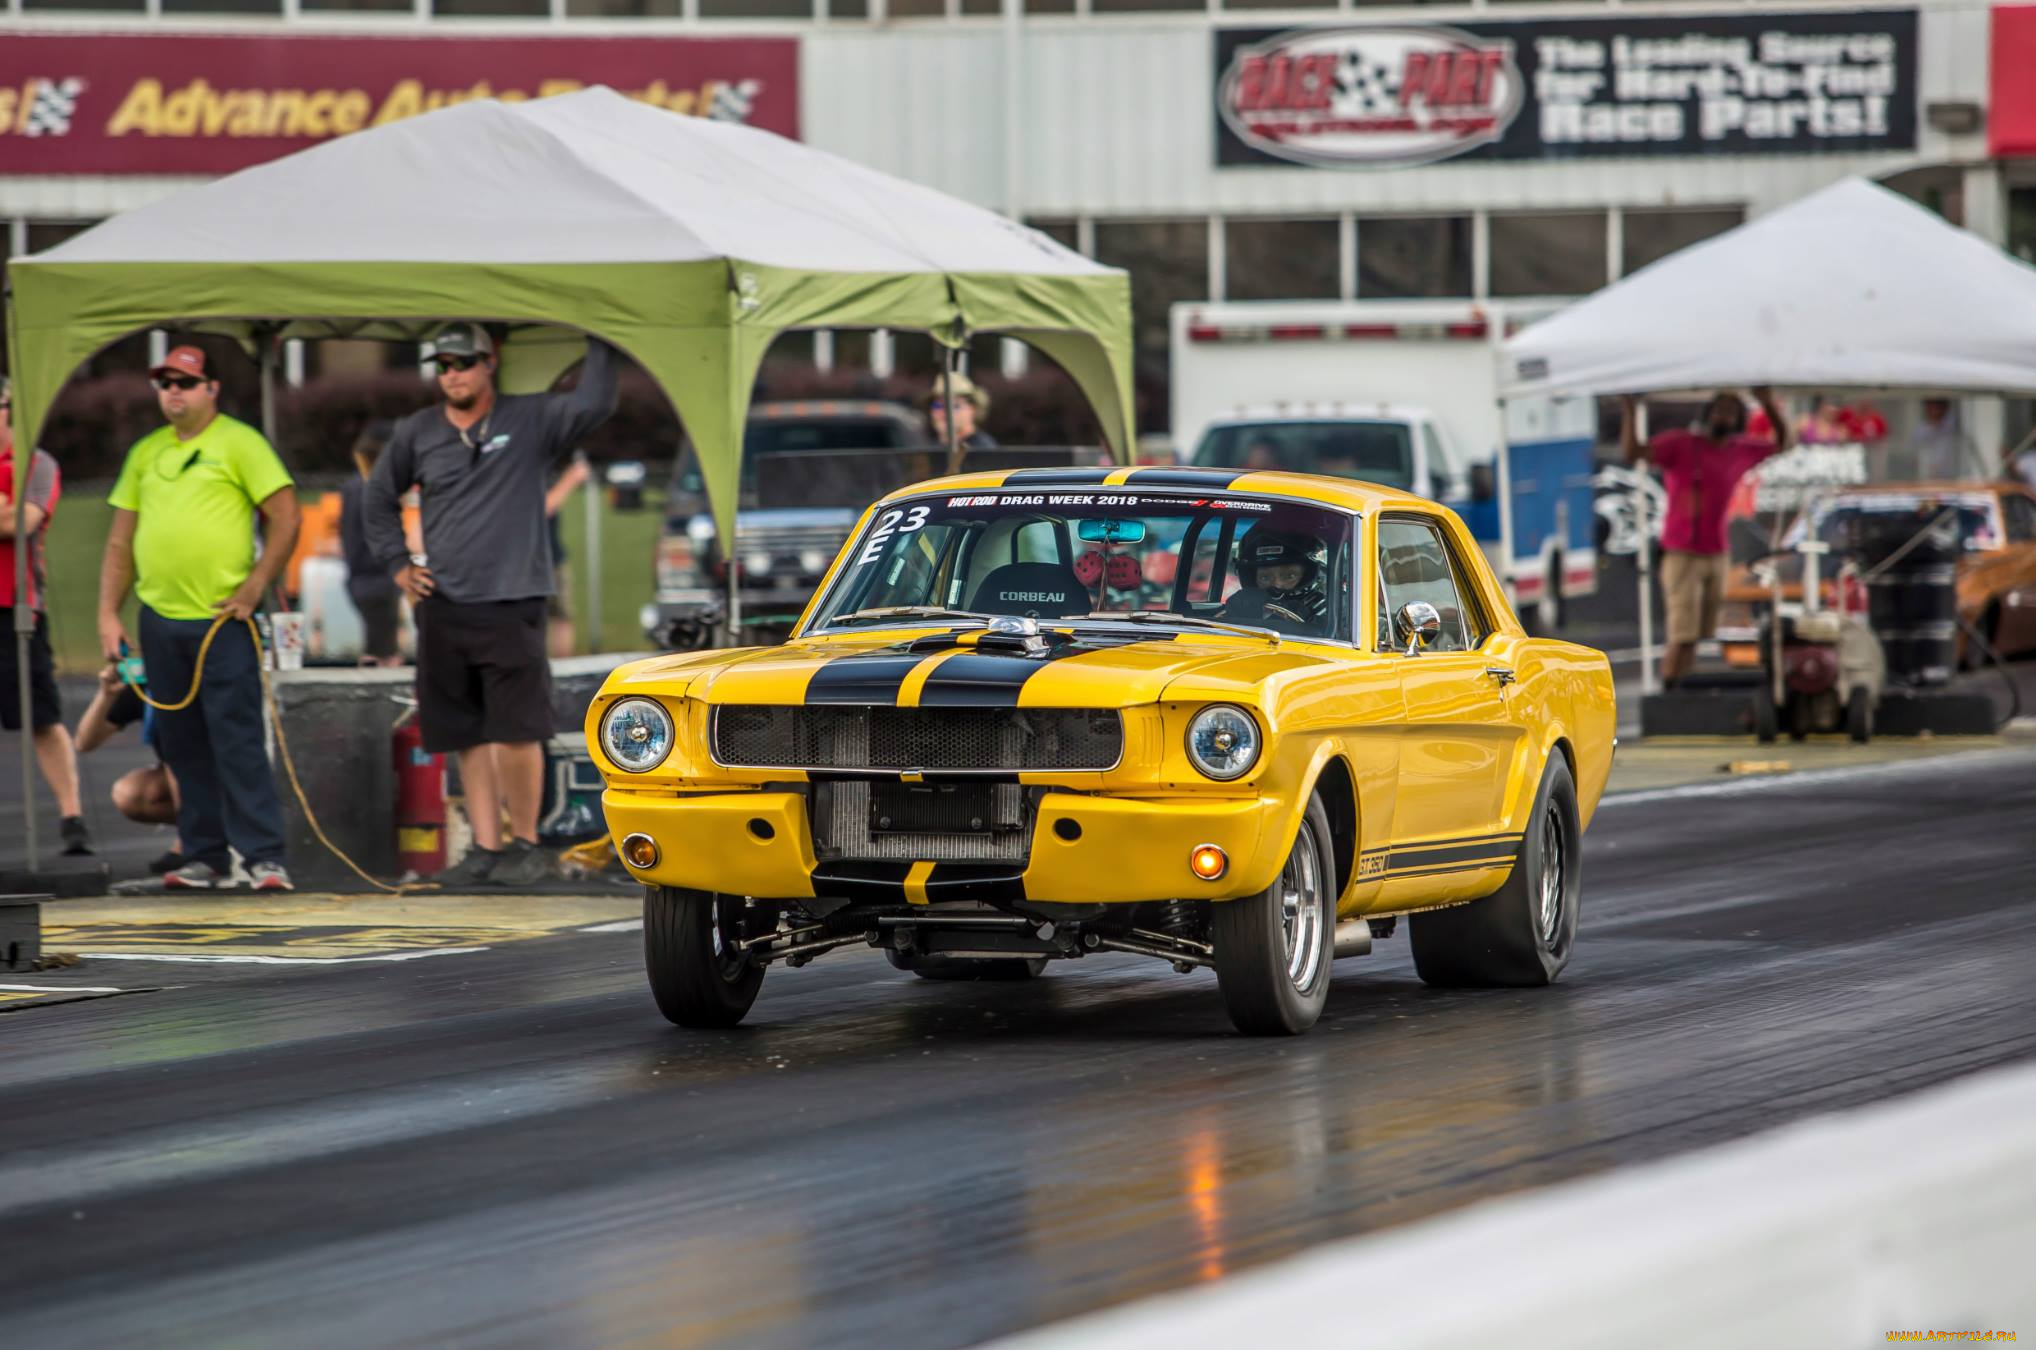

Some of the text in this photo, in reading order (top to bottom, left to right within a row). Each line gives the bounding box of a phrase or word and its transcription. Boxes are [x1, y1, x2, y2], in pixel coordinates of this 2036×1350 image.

[1534, 31, 1895, 73] The Leading Source
[1534, 69, 1605, 101] for
[104, 77, 370, 137] Advance
[1540, 103, 1685, 143] Race
[1699, 96, 1888, 140] Parts!
[1000, 495, 1045, 506] DRAG
[1048, 495, 1094, 506] WEEK
[1096, 495, 1139, 506] 2018
[870, 506, 931, 539] 23
[857, 535, 890, 567] E
[1000, 591, 1065, 602] CORBEAU
